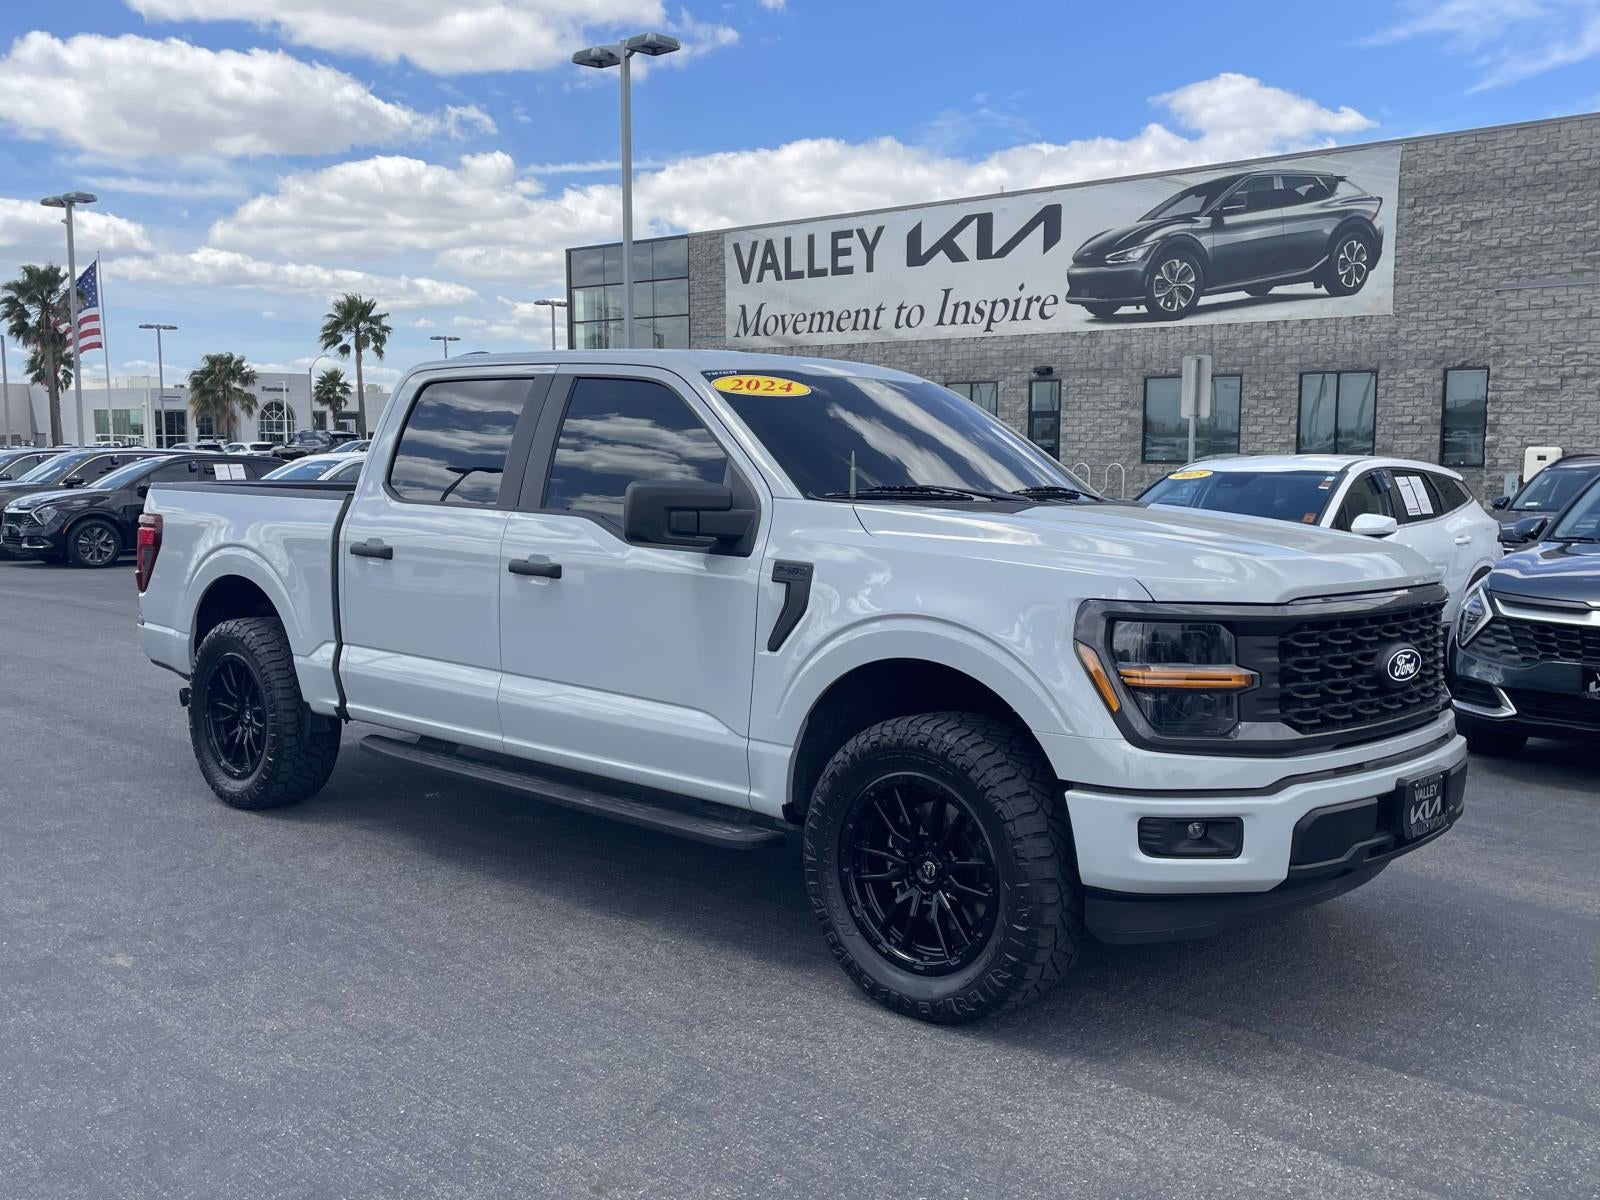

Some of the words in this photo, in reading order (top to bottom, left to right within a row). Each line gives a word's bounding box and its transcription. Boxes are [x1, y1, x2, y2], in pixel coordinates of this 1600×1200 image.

[733, 225, 885, 284] VALLEY
[906, 203, 1062, 268] KIA
[733, 302, 887, 338] Movement
[894, 300, 925, 329] to
[934, 282, 1059, 332] Inspire
[730, 378, 793, 393] 2024
[1394, 653, 1416, 677] Ford
[1414, 783, 1439, 803] VALLEY
